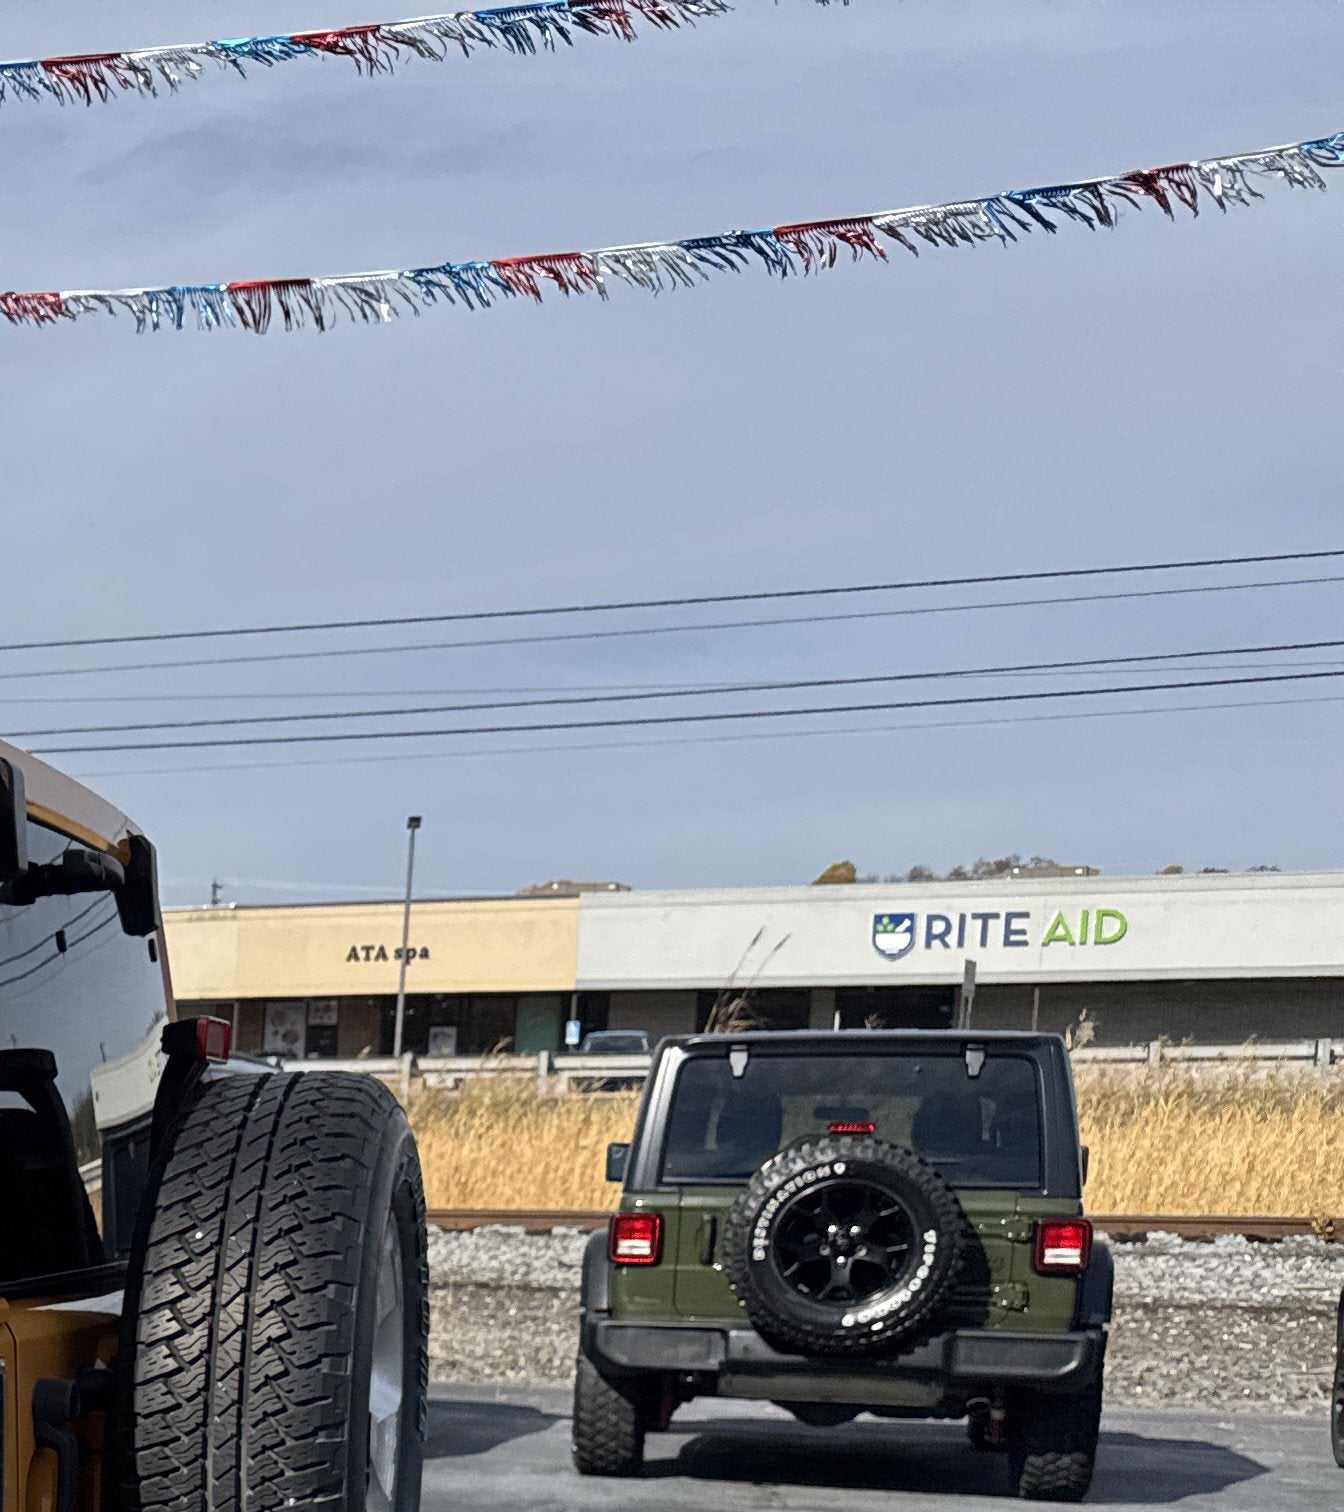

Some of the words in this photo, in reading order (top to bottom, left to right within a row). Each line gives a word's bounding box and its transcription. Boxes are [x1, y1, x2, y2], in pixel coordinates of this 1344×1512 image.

[924, 911, 1030, 949] RITE
[1041, 908, 1128, 947] AID
[345, 945, 389, 962] ATA
[394, 946, 430, 966] spa
